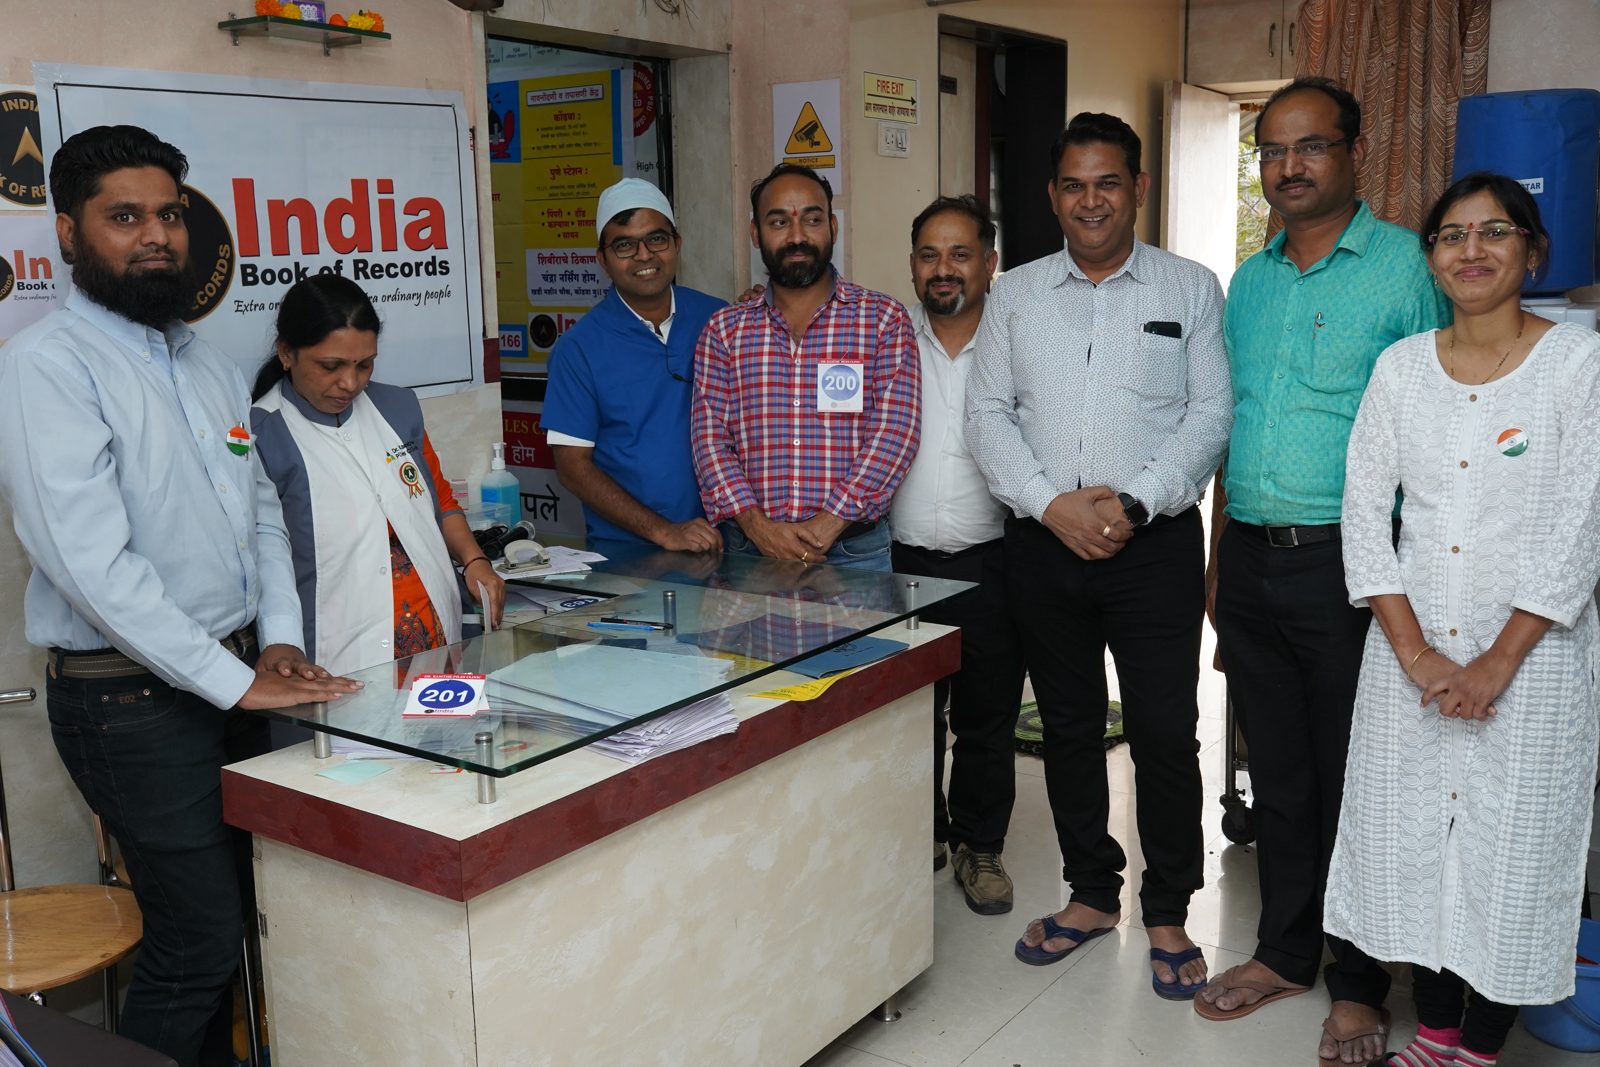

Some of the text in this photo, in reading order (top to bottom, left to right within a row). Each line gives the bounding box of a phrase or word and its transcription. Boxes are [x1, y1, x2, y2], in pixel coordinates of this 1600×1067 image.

[876, 79, 904, 96] FIRE EXIT
[550, 165, 561, 180] पुणे
[563, 165, 583, 177] स्टेशन
[636, 161, 654, 172] High
[9, 182, 27, 197] OF
[231, 178, 448, 258] India
[240, 261, 310, 287] Book
[352, 255, 450, 281] Records
[541, 269, 600, 284] चंद्रा नर्सिंग होम,
[17, 281, 48, 291] Book
[233, 299, 265, 316] Extra
[381, 287, 422, 308] ordinary
[424, 284, 452, 306] people
[501, 334, 521, 348] 166
[825, 376, 856, 391] 200
[511, 440, 536, 464] होम
[421, 690, 468, 703] 201
